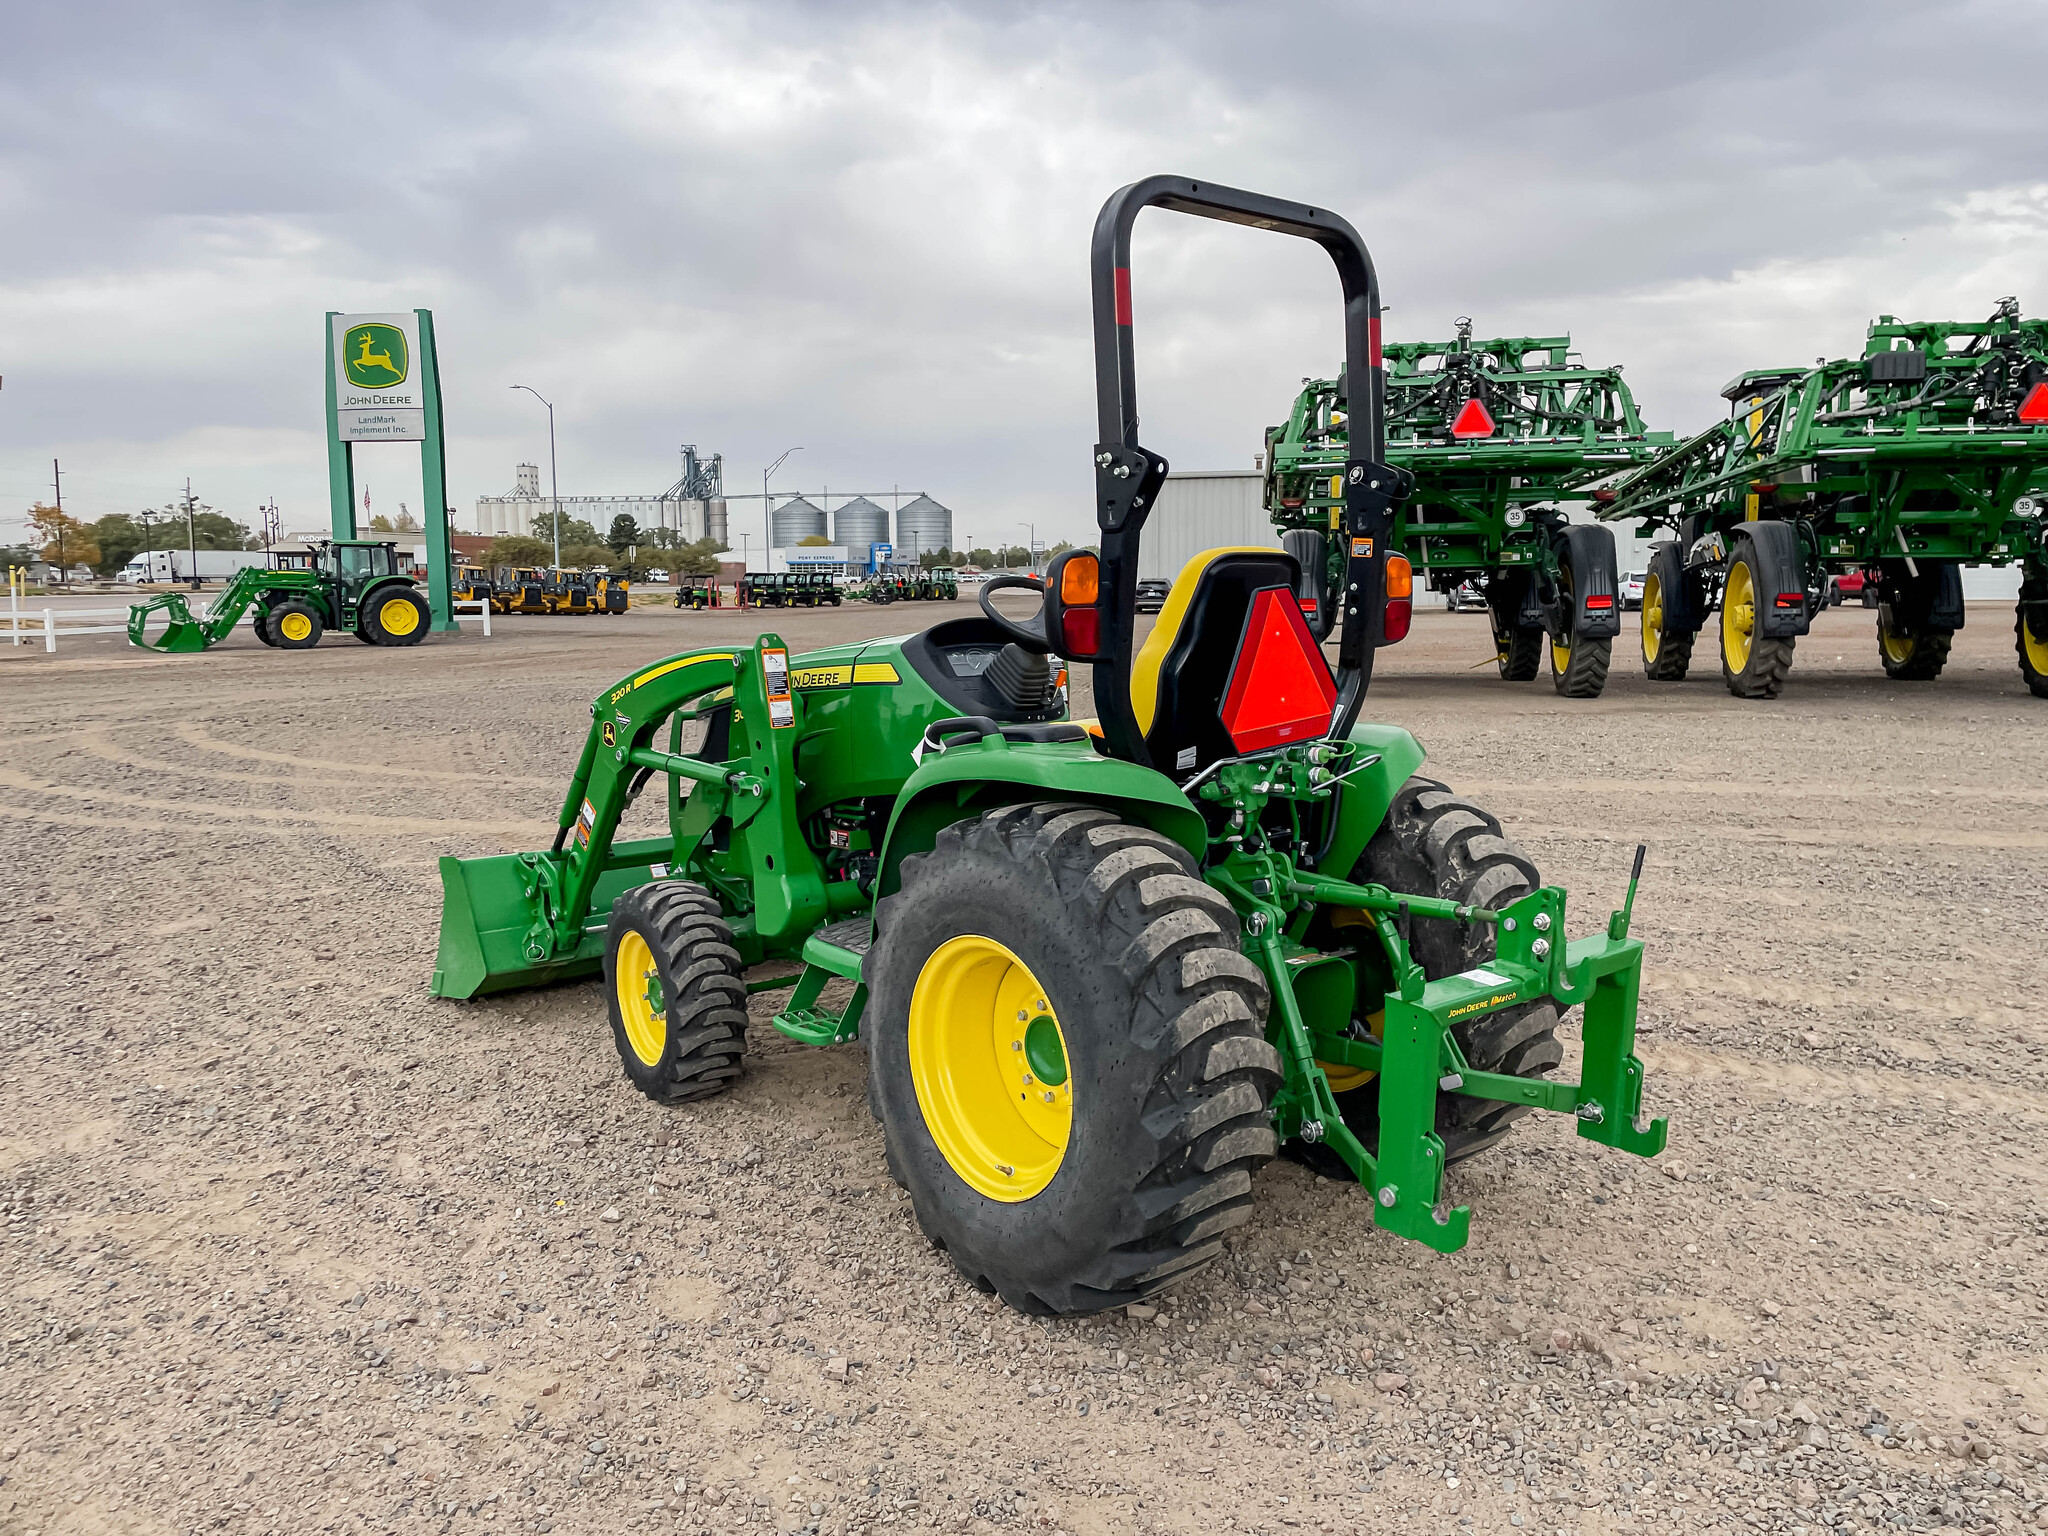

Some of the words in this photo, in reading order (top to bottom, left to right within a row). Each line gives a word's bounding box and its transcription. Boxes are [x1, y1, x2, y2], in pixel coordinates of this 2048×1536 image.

[344, 396, 372, 405] JOHN
[373, 395, 412, 404] DEERE
[358, 416, 396, 424] LandMark
[349, 427, 391, 435] Implement
[564, 504, 697, 512] GOTHENBUG
[2019, 501, 2030, 510] 35
[1510, 512, 1520, 520] 35
[802, 673, 839, 687] DEERE
[1448, 1008, 1466, 1018] JOHN
[1466, 1001, 1488, 1012] DEERE
